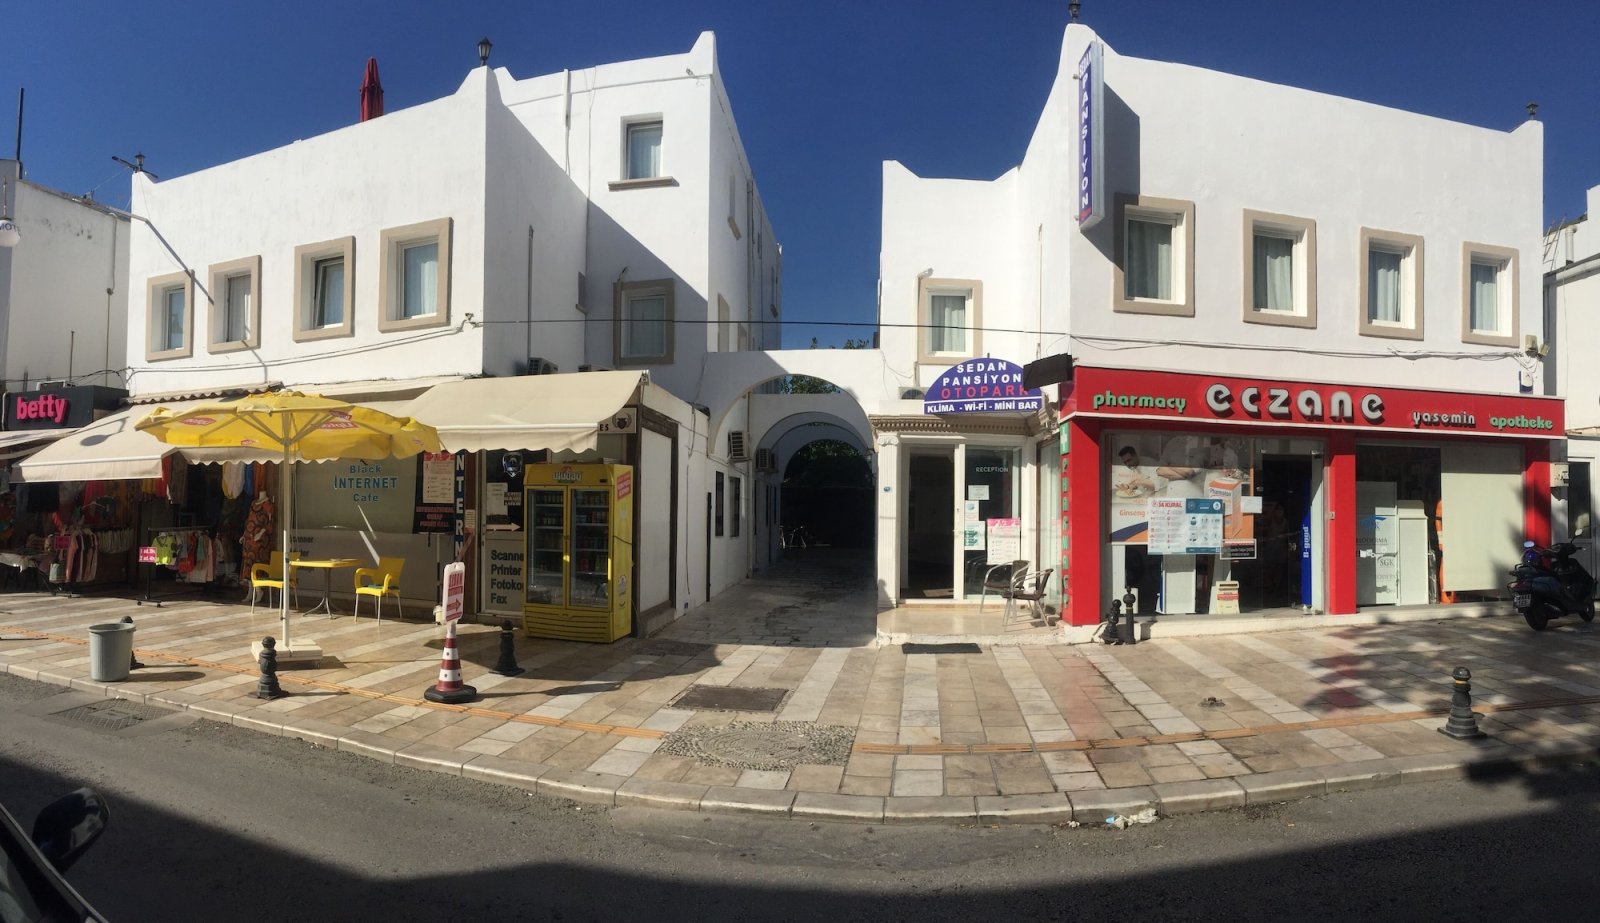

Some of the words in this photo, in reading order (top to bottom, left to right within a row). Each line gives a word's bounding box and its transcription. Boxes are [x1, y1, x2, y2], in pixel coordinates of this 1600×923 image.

[957, 362, 1007, 373] SEDAN
[943, 373, 1021, 386] PANSİYON
[941, 384, 1029, 399] OTOPARK
[927, 403, 955, 413] KLİMA
[995, 400, 1016, 410] MİNİ
[1018, 401, 1038, 410] BAR
[1093, 390, 1186, 413] pharmacy
[1206, 384, 1384, 422] eczane
[16, 395, 68, 424] betty
[1412, 411, 1476, 427] yasemin
[1490, 415, 1553, 429] apotheke
[350, 465, 382, 474] Black
[353, 493, 380, 502] Cafe
[490, 564, 522, 576] Printer
[490, 579, 523, 590] Fotoko
[490, 593, 508, 605] Fax
